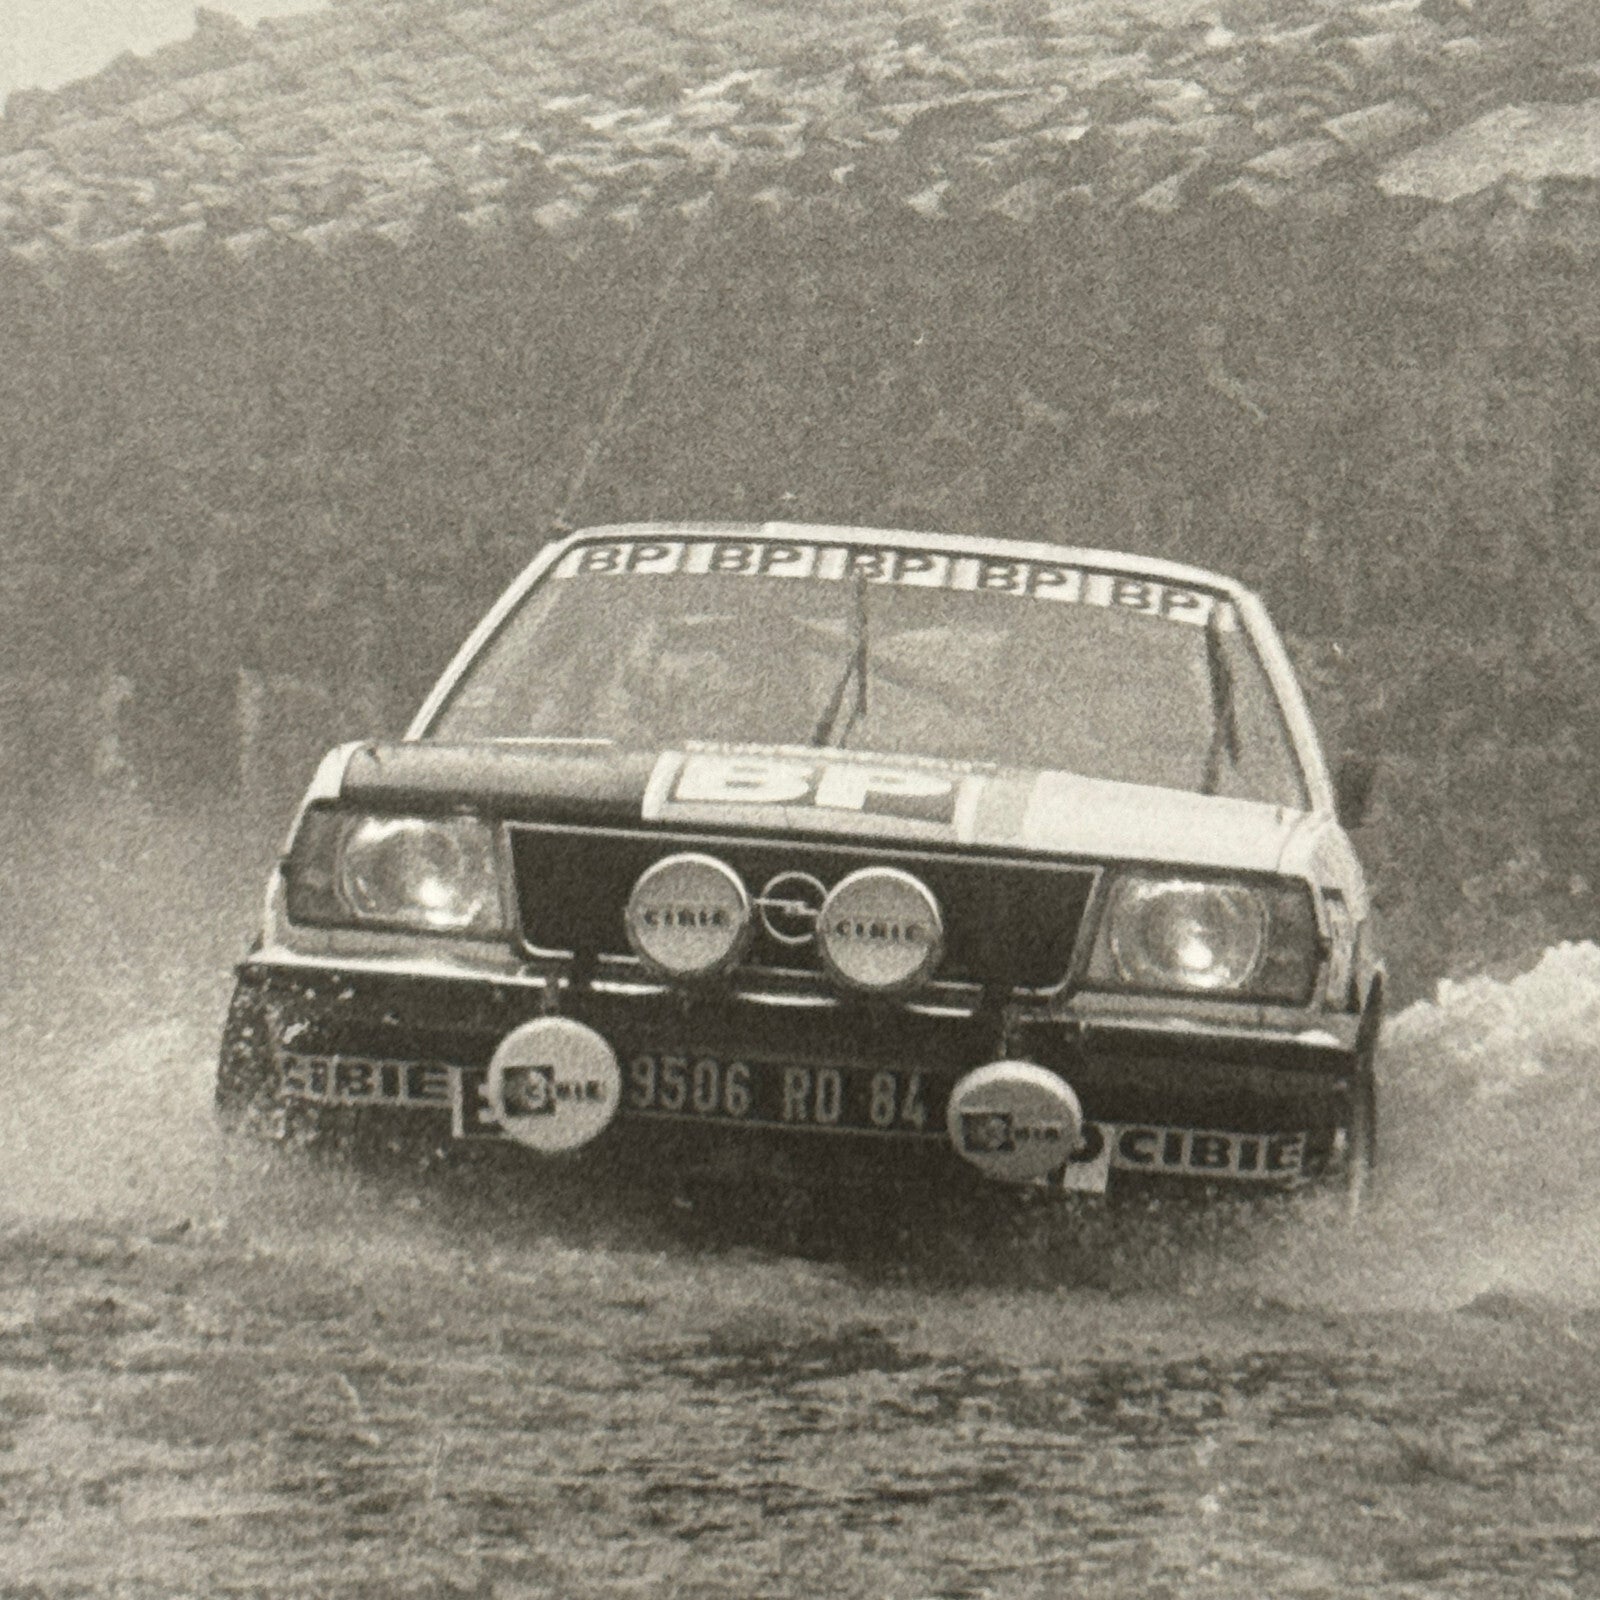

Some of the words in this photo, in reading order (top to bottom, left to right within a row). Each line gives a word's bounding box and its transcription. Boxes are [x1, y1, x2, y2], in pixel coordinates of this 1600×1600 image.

[578, 545, 666, 574] BP
[709, 546, 804, 577] BP
[850, 552, 937, 585] BP
[979, 562, 1069, 599] BP
[1113, 578, 1200, 619] BP
[675, 752, 952, 811] BP
[630, 1055, 751, 1117] 9506
[869, 1067, 926, 1128] 84
[1118, 1128, 1301, 1173] CIBIE
